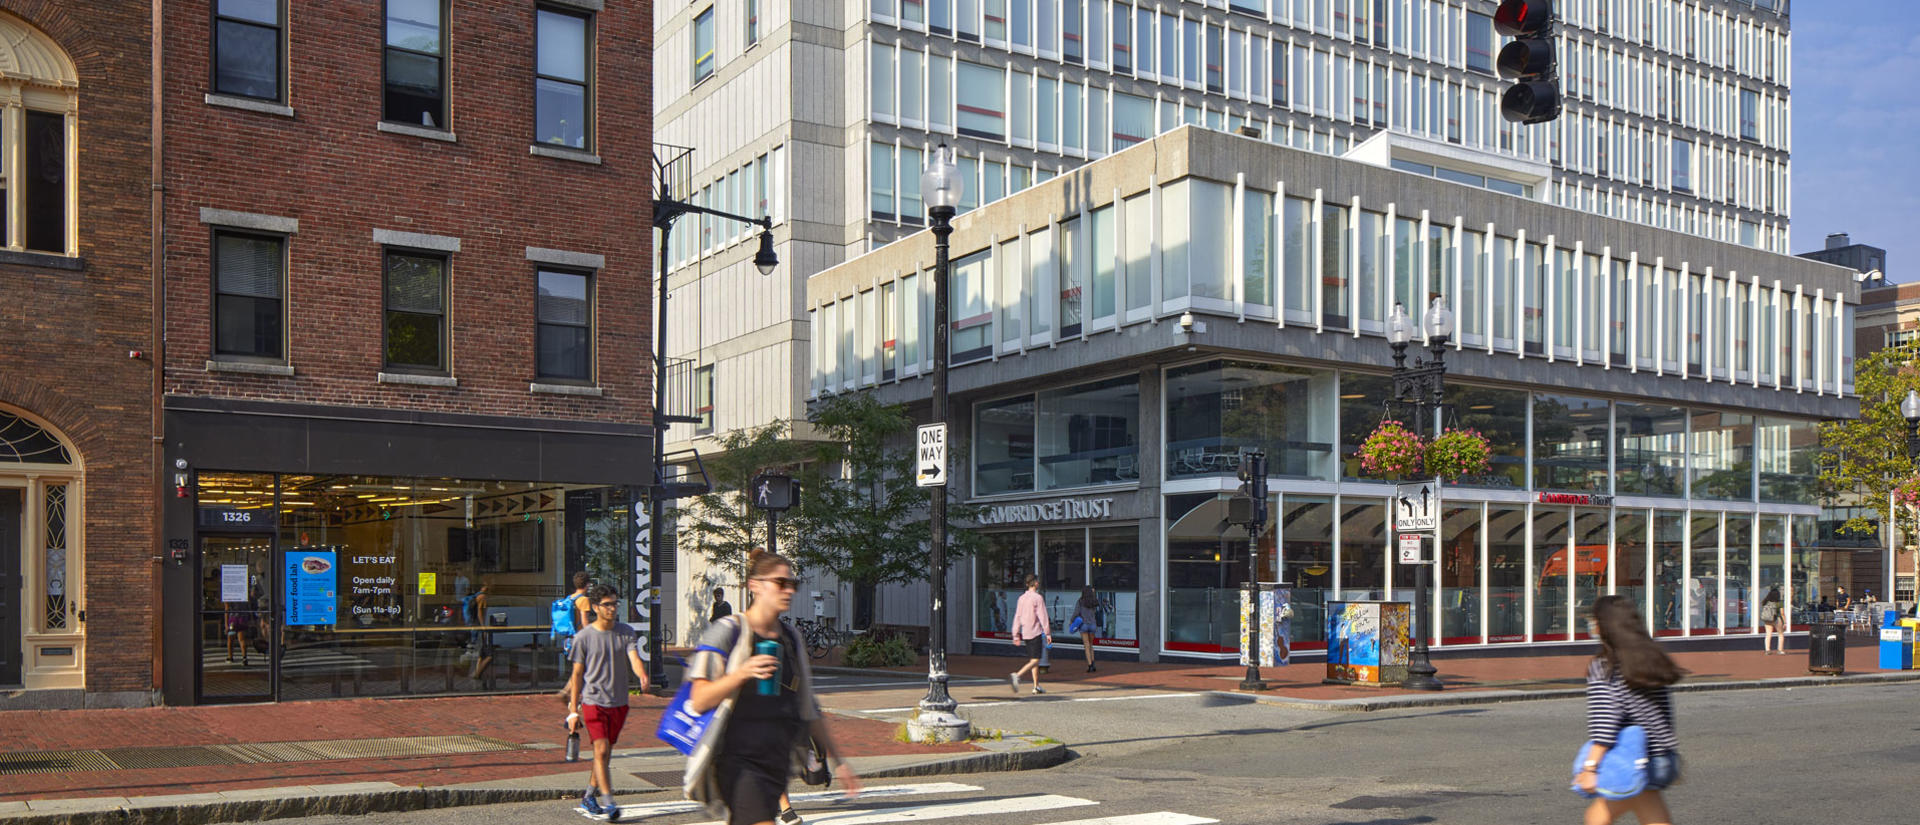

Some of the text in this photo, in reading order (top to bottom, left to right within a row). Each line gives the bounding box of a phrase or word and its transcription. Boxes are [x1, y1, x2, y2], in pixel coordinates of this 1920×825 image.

[921, 429, 942, 445] ONE
[921, 446, 943, 461] WAY
[222, 512, 251, 522] 1326
[1416, 518, 1434, 526] ONLY
[352, 556, 396, 564] LET'S EAT
[352, 576, 396, 586] Open daily
[290, 563, 298, 623] clover food lab
[352, 586, 391, 595] 7am-7pm
[352, 605, 372, 614] (Sun
